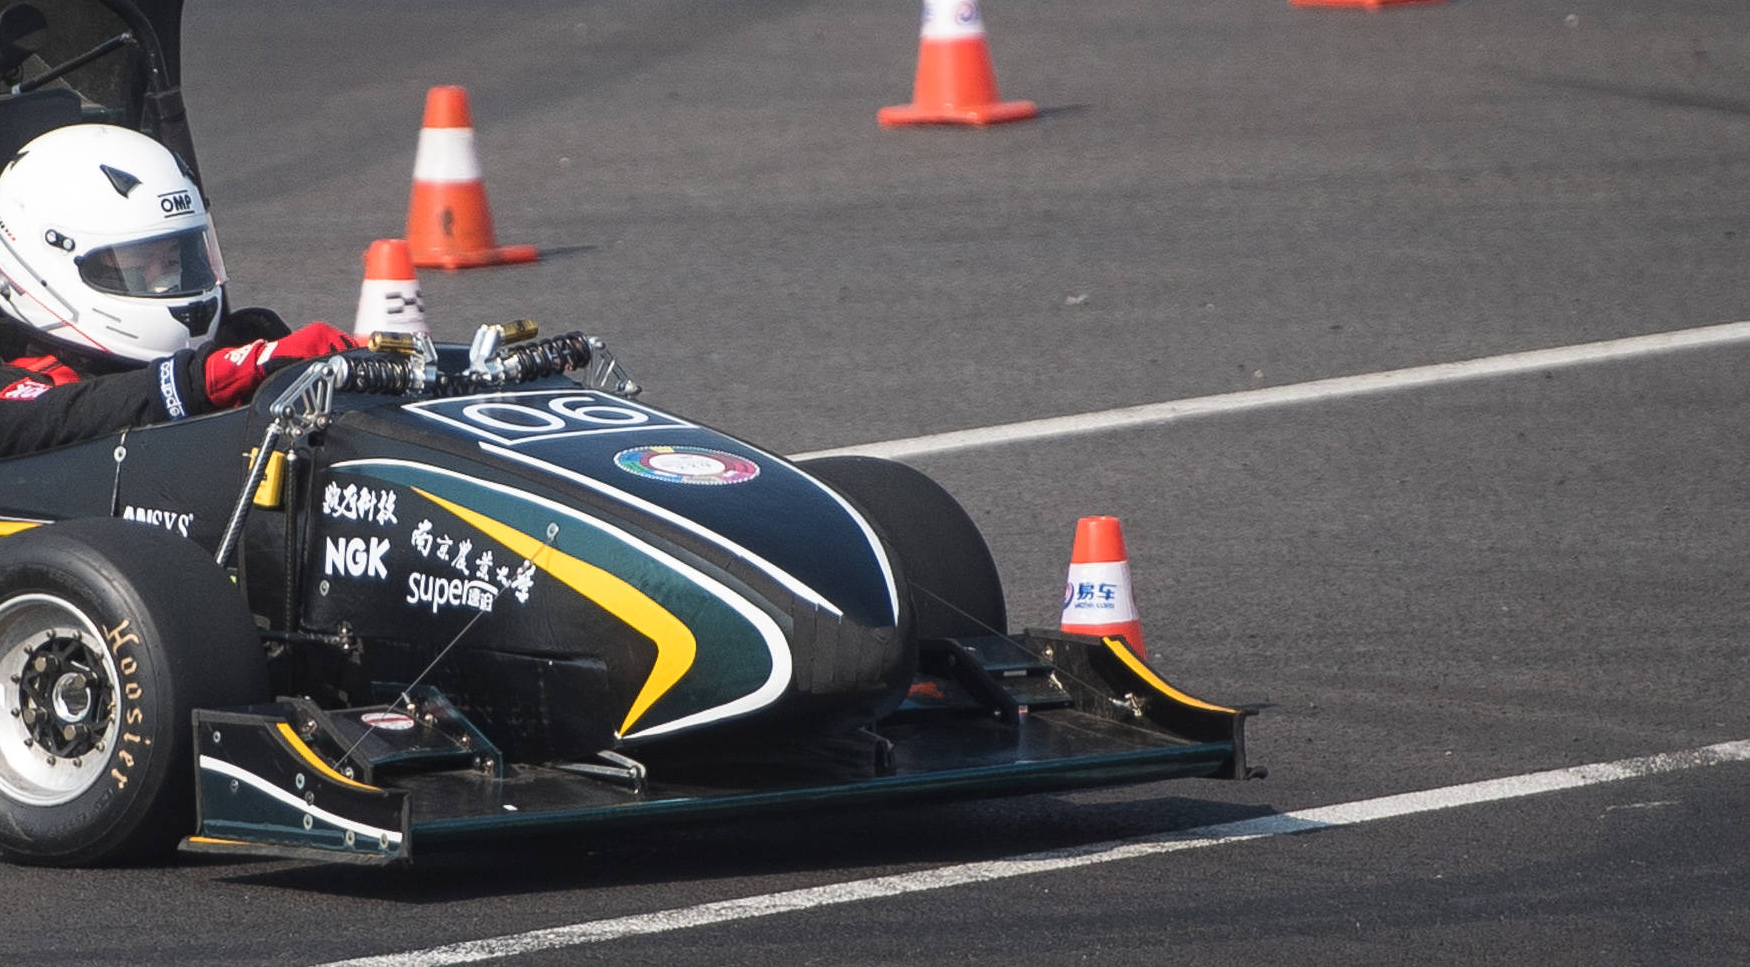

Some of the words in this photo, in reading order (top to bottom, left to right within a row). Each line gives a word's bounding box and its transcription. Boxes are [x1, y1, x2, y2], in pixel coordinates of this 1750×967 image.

[160, 193, 192, 213] OMP
[461, 395, 650, 433] 06
[324, 536, 391, 580] NGK
[1076, 582, 1117, 601] 易车
[103, 617, 153, 790] Hoosier
